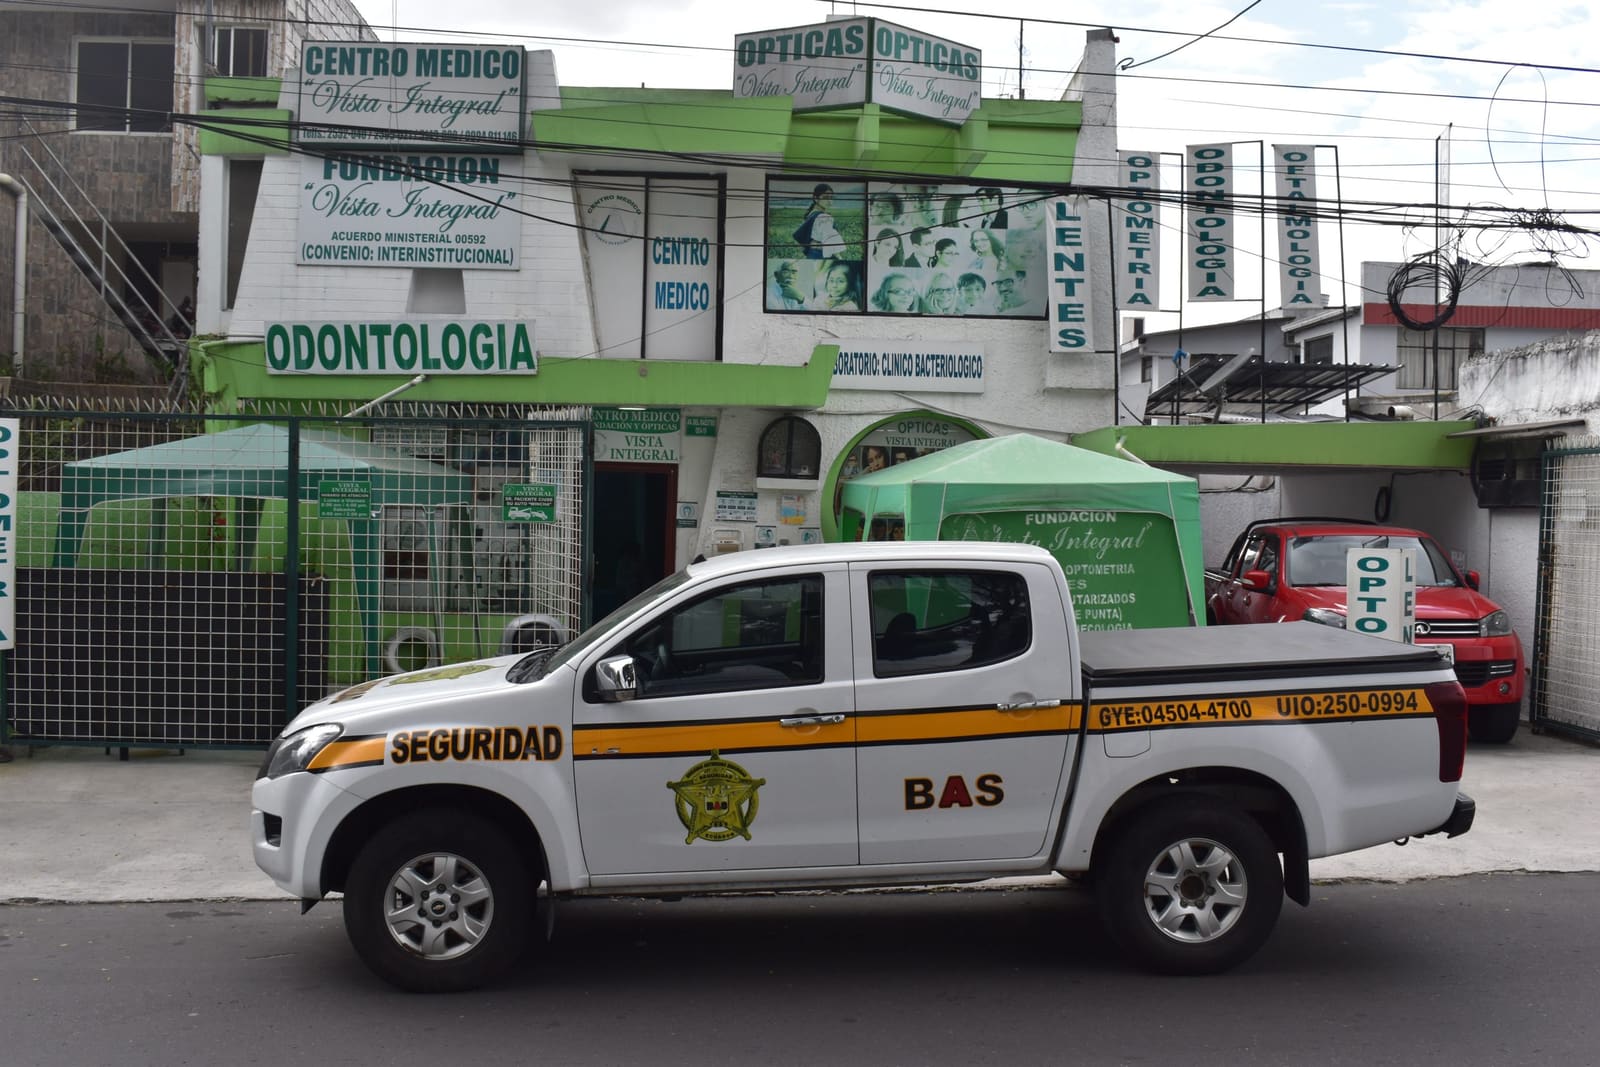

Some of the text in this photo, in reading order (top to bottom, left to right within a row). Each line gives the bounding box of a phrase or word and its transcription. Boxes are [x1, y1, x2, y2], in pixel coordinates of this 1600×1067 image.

[738, 25, 864, 68] OPTICAS
[877, 26, 978, 81] OPTICAS
[305, 46, 519, 80] CENTRO MEDICO
[323, 155, 499, 184] FUNDACION
[1125, 156, 1154, 305] OPTOMETRIA
[1194, 148, 1227, 297] ODONTOLOGIA
[1283, 151, 1313, 304] OFTALMOLOGIA
[331, 231, 486, 244] ACUERDO MINISTERIAL 00592
[652, 237, 710, 266] CENTRO
[301, 242, 514, 266] (CONVENIO: INTERINSTITUCIONAL)
[1054, 201, 1086, 348] LENTES
[655, 281, 710, 311] MEDICO
[266, 323, 536, 371] ODONTOLOGIA
[881, 353, 913, 377] CLINICO
[915, 354, 983, 379] BACTERIOLOGICO
[631, 411, 680, 423] MEDICO
[897, 421, 949, 436] OPTICAS
[610, 448, 679, 461] INTEGRAL
[625, 435, 664, 448] VISTA
[885, 436, 912, 446] VISTA
[1025, 512, 1117, 525] FUNDACION
[1065, 563, 1135, 576] OPTOMETRIA
[1085, 607, 1122, 621] PUNTA)
[1100, 699, 1252, 728] GYE:04504-4700
[1276, 691, 1418, 717] UIO:250-0994
[391, 725, 563, 765] SEGURIDAD
[904, 774, 1004, 810] BAS
